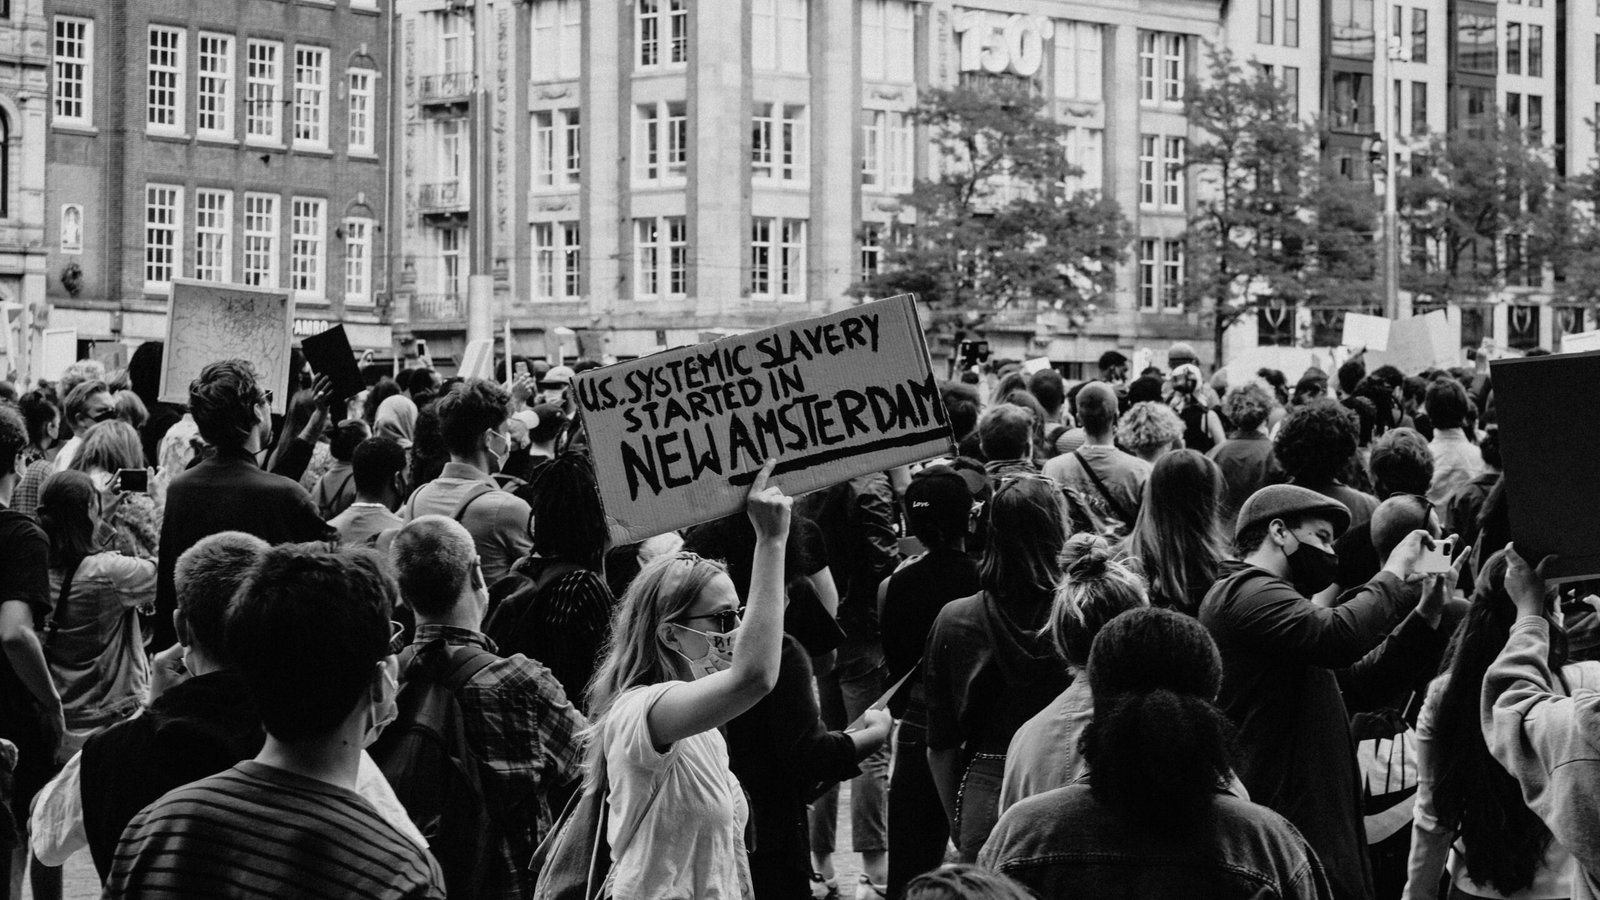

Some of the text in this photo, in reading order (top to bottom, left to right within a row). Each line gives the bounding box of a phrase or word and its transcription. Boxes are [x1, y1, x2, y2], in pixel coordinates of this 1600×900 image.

[621, 345, 753, 404] SYSTEMIC
[756, 314, 879, 369] SLAVERY
[623, 364, 805, 431] STARTED IN
[620, 372, 946, 501] NEW AMSTERDAM
